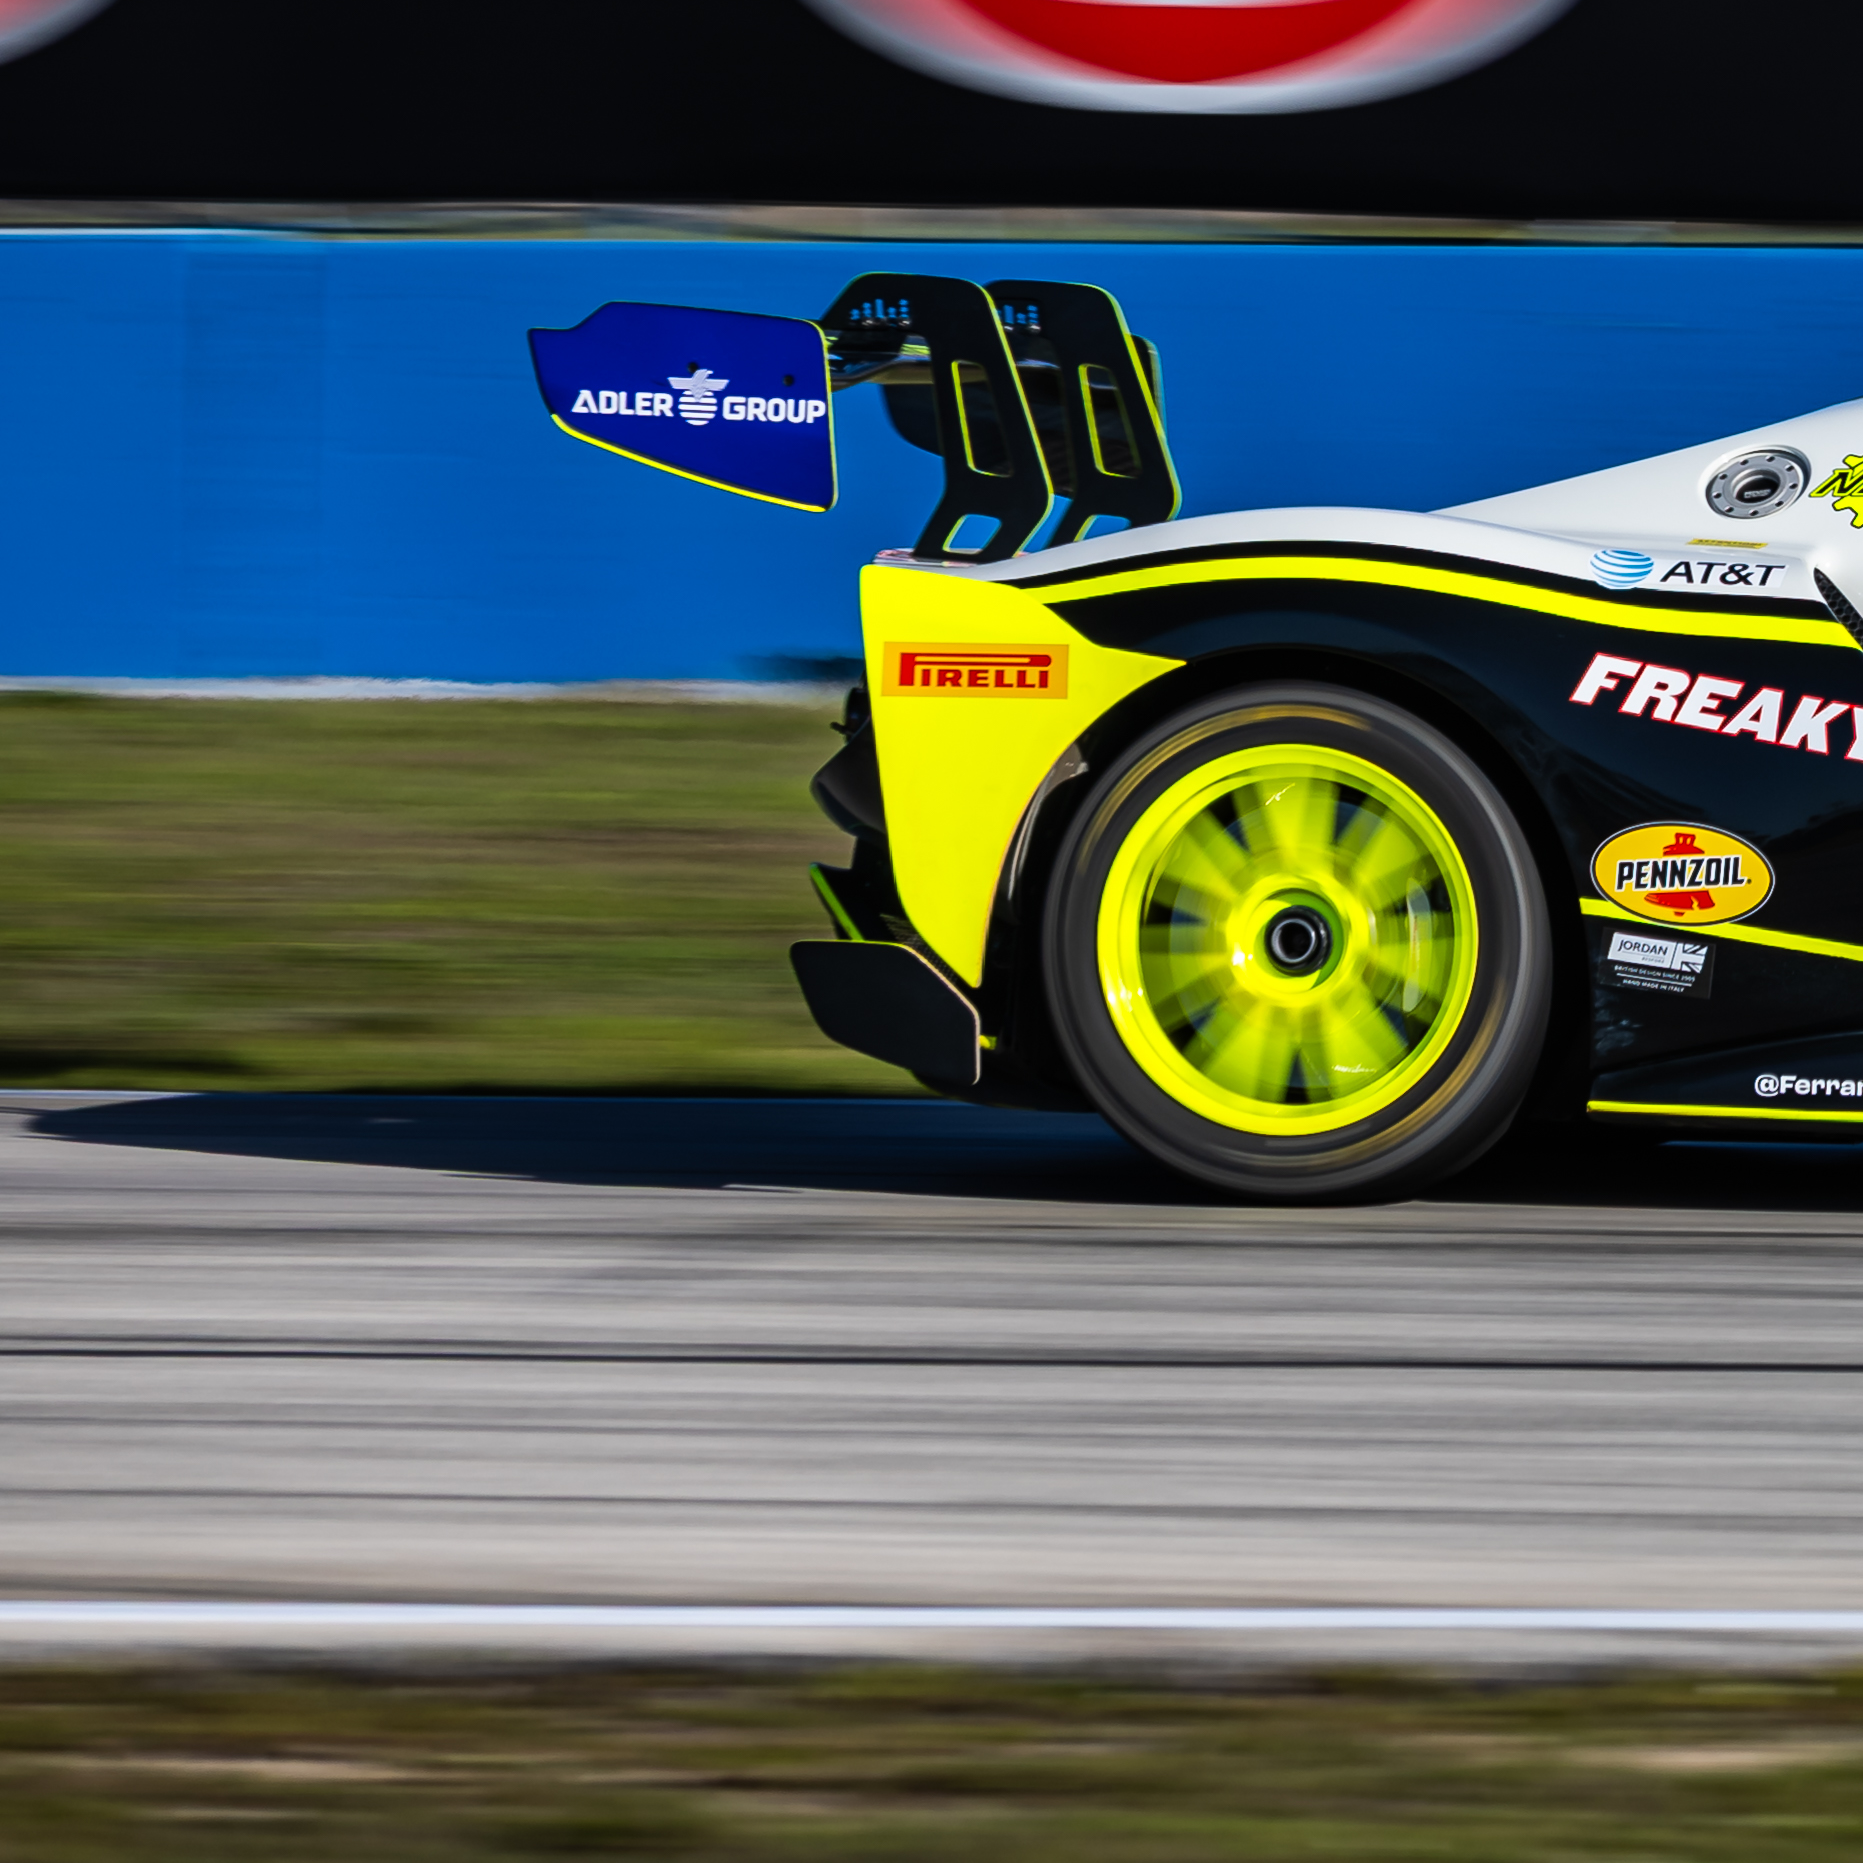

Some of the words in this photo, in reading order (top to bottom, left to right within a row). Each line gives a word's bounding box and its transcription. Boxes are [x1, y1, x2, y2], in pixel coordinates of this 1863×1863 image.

[571, 389, 675, 418] ADLER
[722, 395, 827, 424] GROUP
[1660, 560, 1786, 587] AT&T
[898, 651, 1053, 689] PIRELLI
[1614, 854, 1748, 893] PENNZOIL
[1617, 939, 1669, 956] JORDAN
[1641, 981, 1660, 989] MADE
